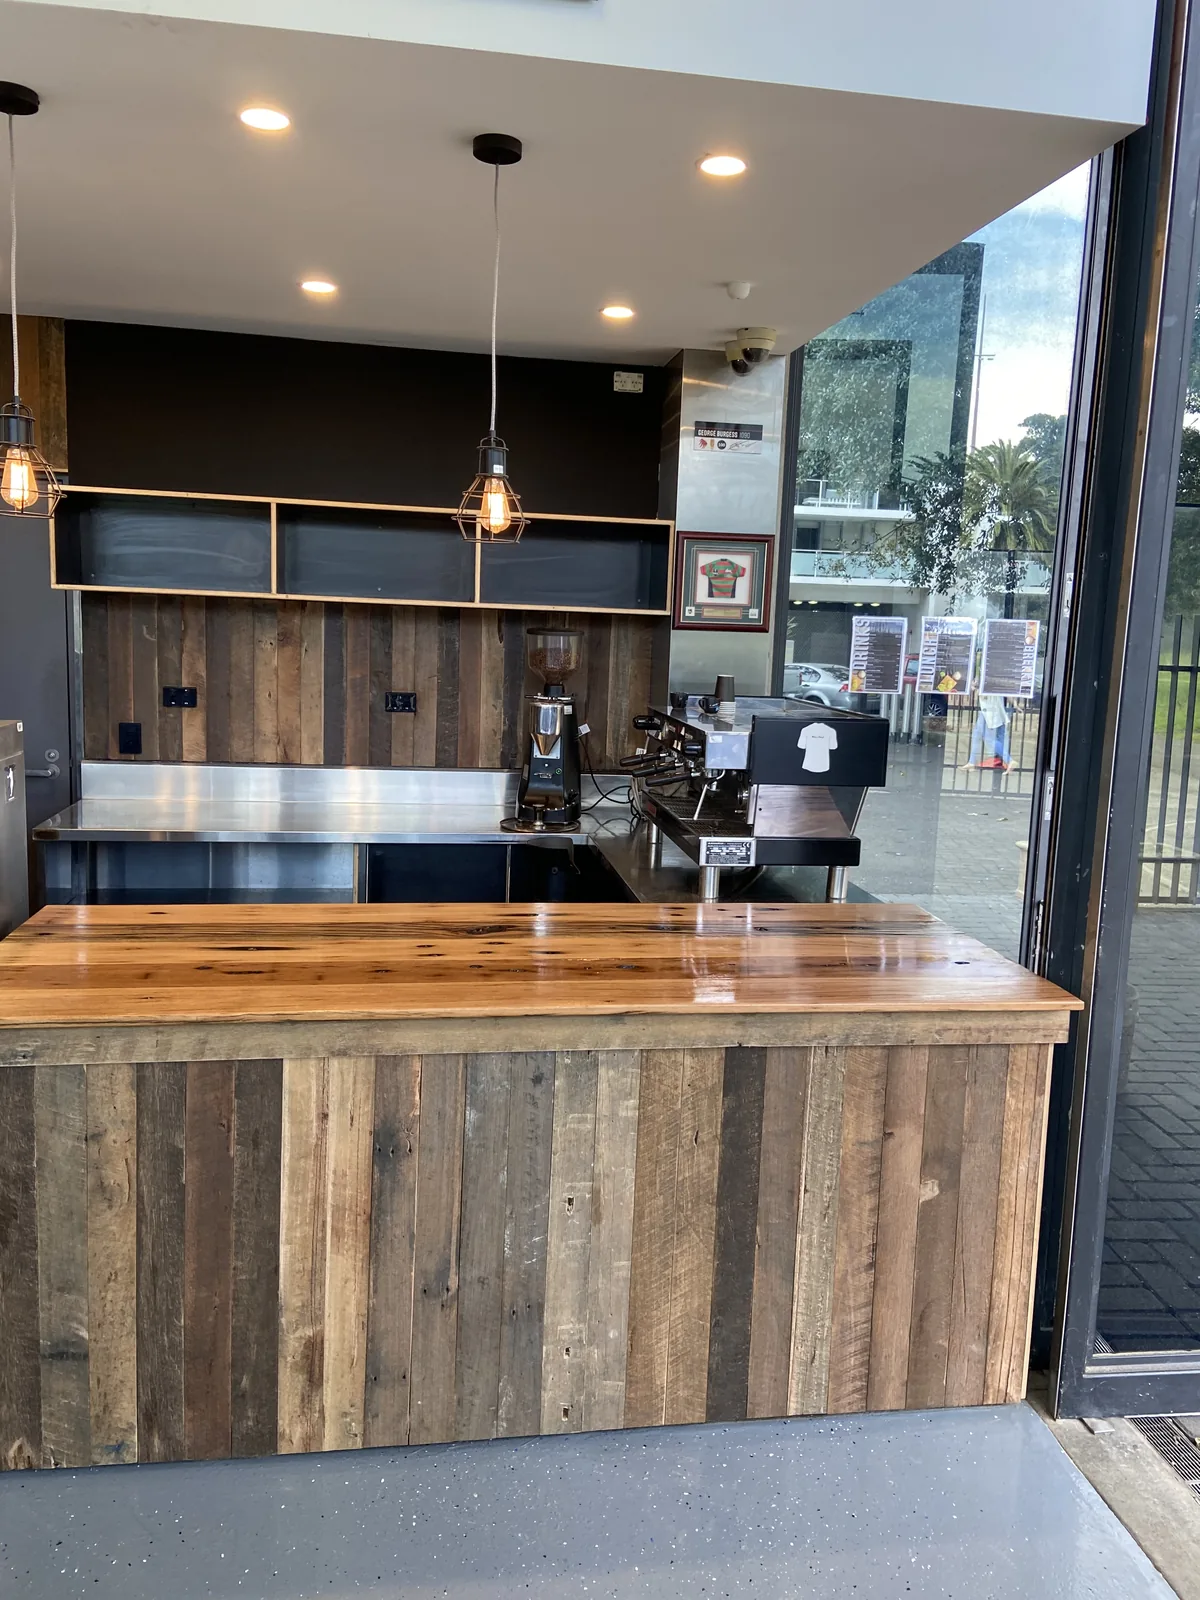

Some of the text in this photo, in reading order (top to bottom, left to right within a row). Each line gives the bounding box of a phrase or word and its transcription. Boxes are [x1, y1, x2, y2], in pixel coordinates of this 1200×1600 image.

[698, 429, 716, 437] GEORGE
[717, 430, 738, 438] BURGESS
[854, 619, 870, 670] DRINKS
[920, 640, 937, 684] LUNCH
